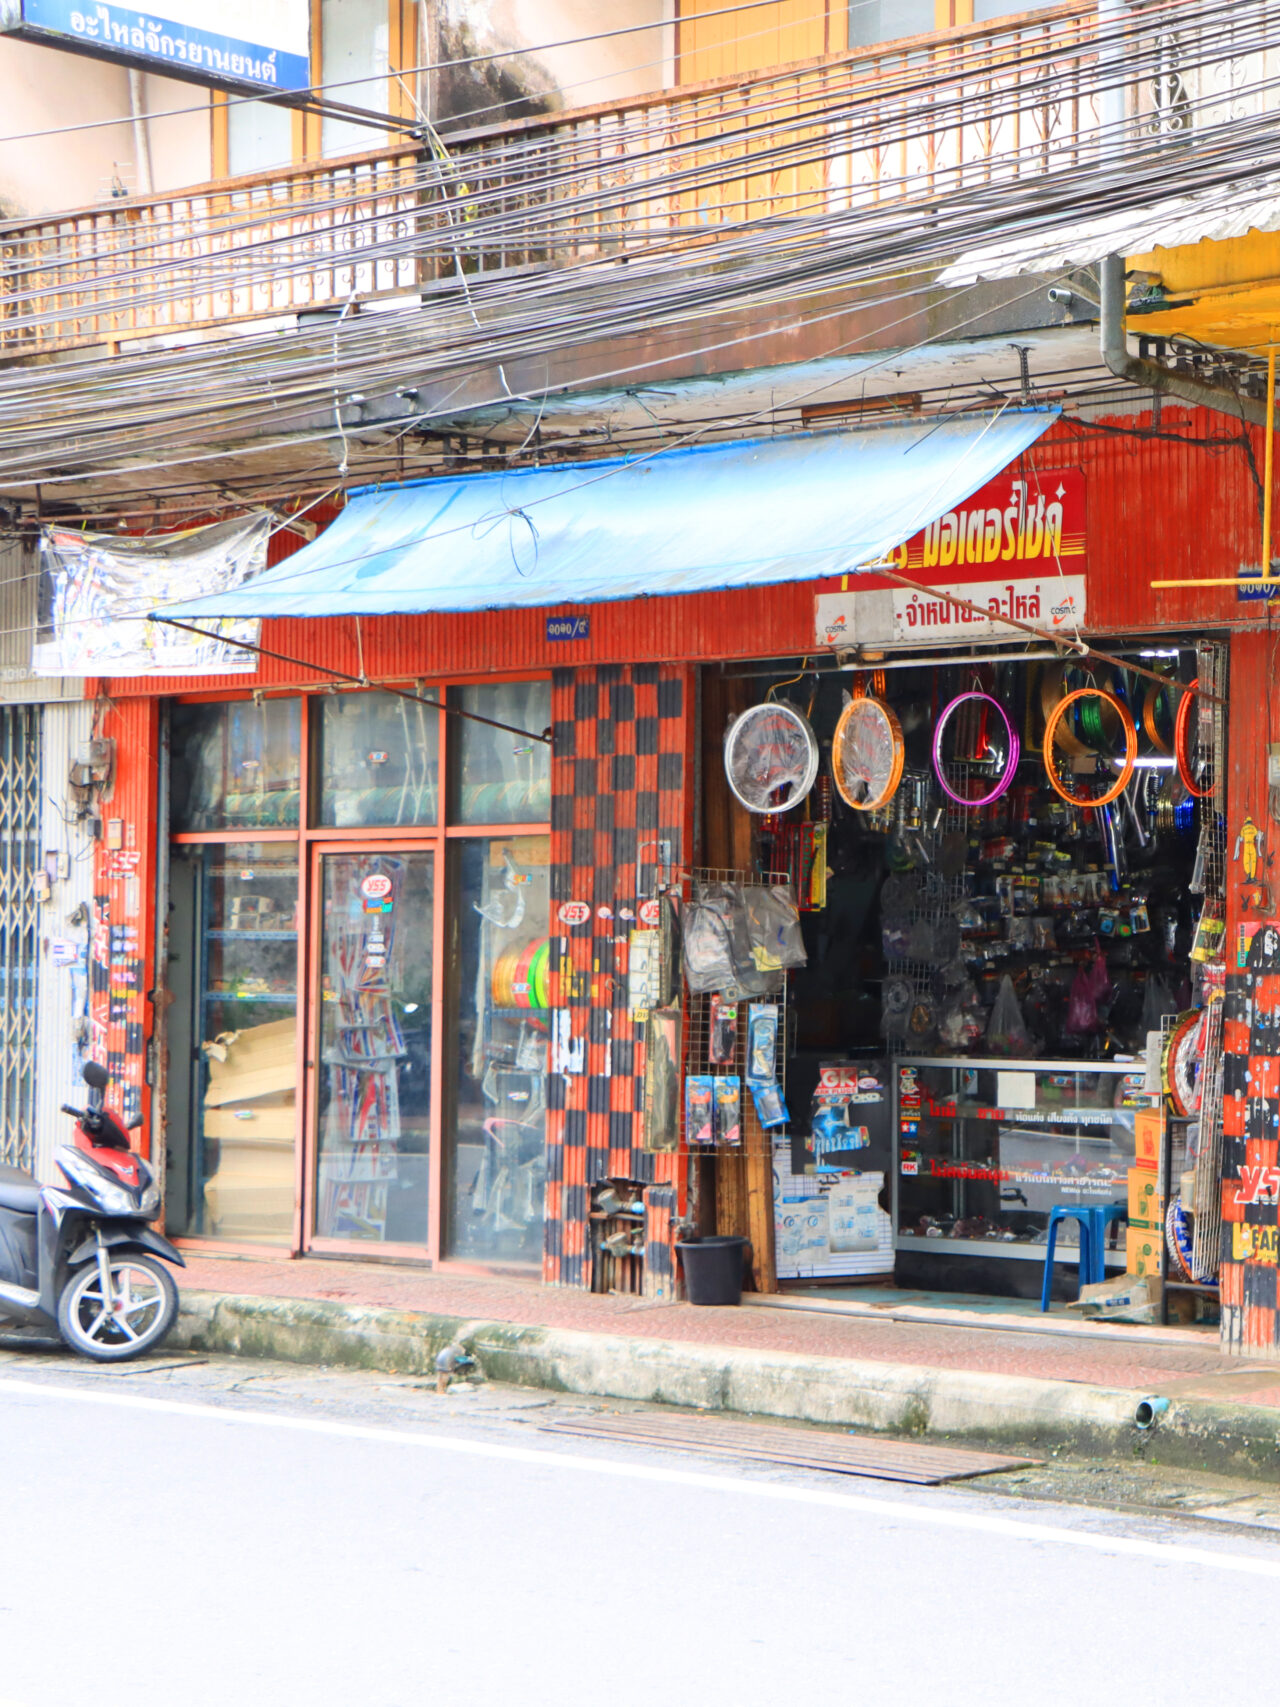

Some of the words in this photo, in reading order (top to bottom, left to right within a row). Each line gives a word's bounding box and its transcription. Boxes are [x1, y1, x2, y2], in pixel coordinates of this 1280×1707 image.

[70, 5, 277, 83] อะไหล่จักรยานยนต์
[988, 585, 1041, 622] อะไหล่
[367, 879, 387, 892] YSS
[565, 905, 586, 919] YSS
[644, 905, 659, 919] YS
[818, 1070, 856, 1088] GK
[902, 1163, 917, 1172] RK
